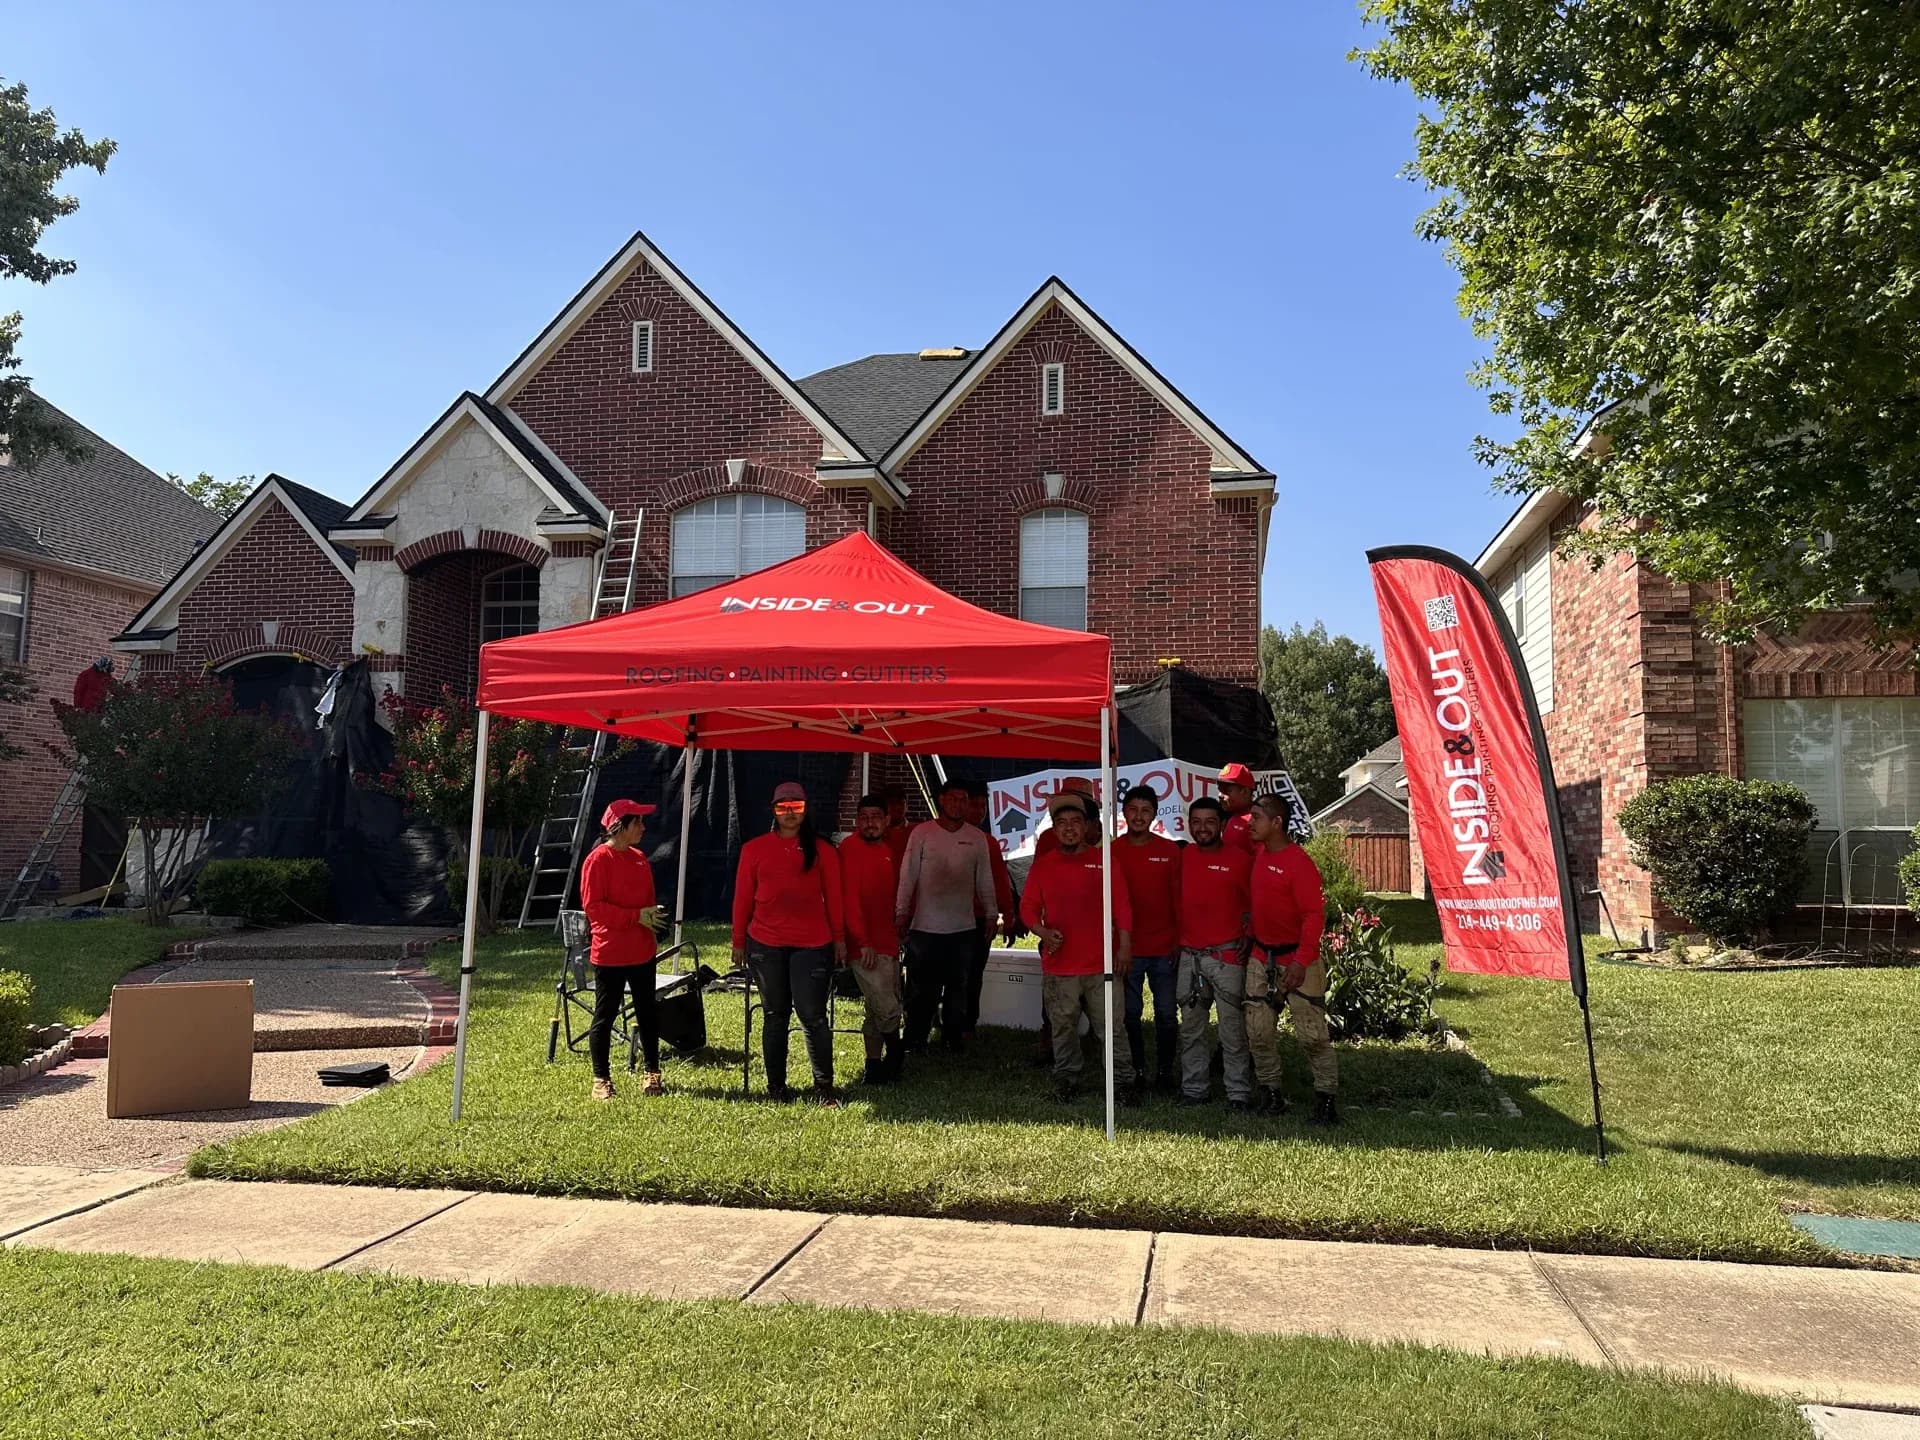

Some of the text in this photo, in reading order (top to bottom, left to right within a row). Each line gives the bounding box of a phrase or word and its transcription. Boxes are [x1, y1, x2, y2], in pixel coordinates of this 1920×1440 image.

[720, 597, 833, 614] INSIDE
[853, 601, 935, 616] OUT
[625, 665, 947, 684] ROOFING PAINTING GUTTERS
[1428, 646, 1471, 732] OUT
[1140, 767, 1217, 803] OUT
[1443, 757, 1492, 886] INSIDE
[1456, 913, 1542, 931] 214-449-4306
